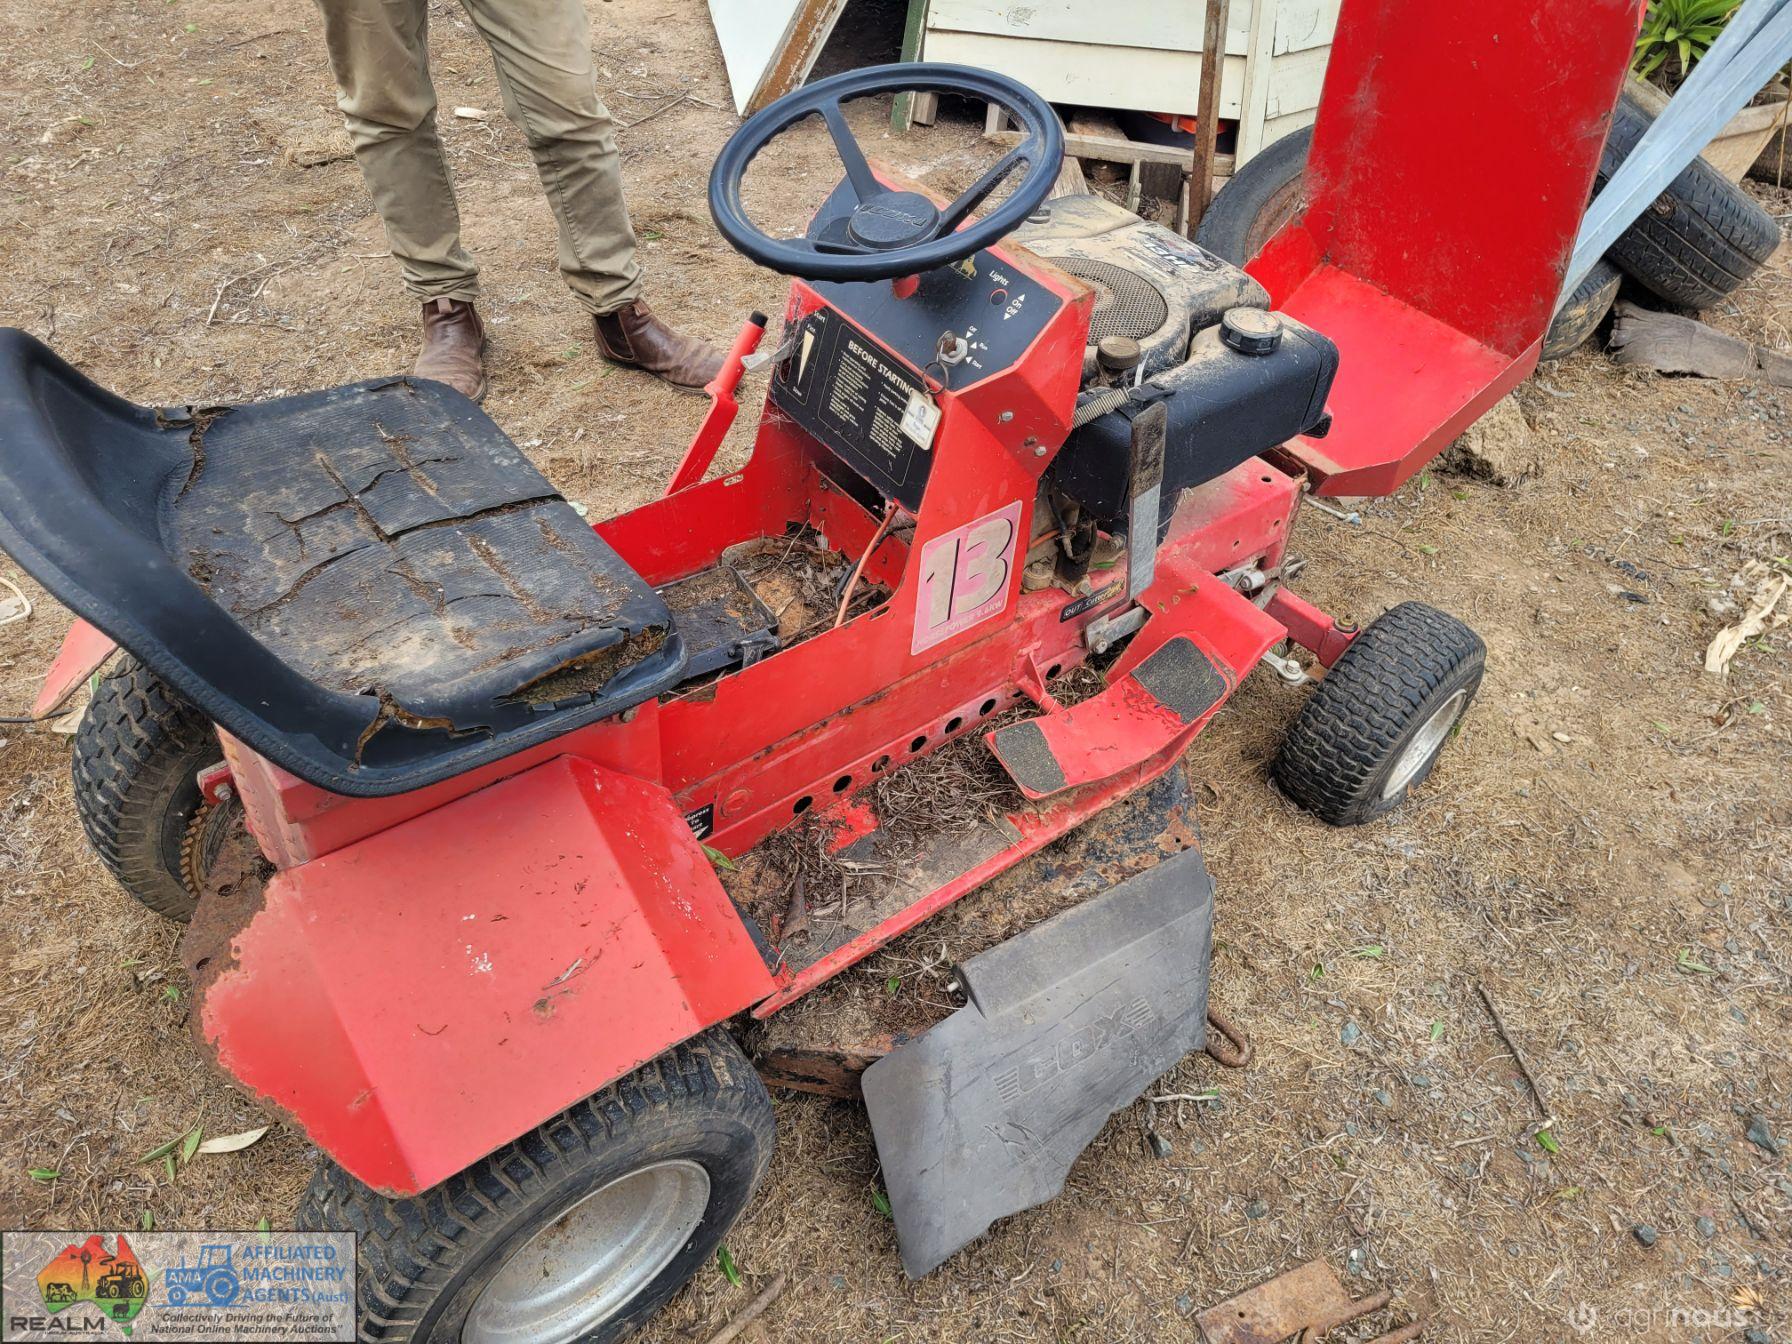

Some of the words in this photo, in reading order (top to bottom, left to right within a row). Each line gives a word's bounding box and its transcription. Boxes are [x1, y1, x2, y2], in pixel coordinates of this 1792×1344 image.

[989, 270, 1010, 286] Lights
[1006, 306, 1018, 316] Off
[1012, 299, 1022, 309] On
[848, 340, 878, 368] BEFORE
[926, 517, 1013, 629] 13
